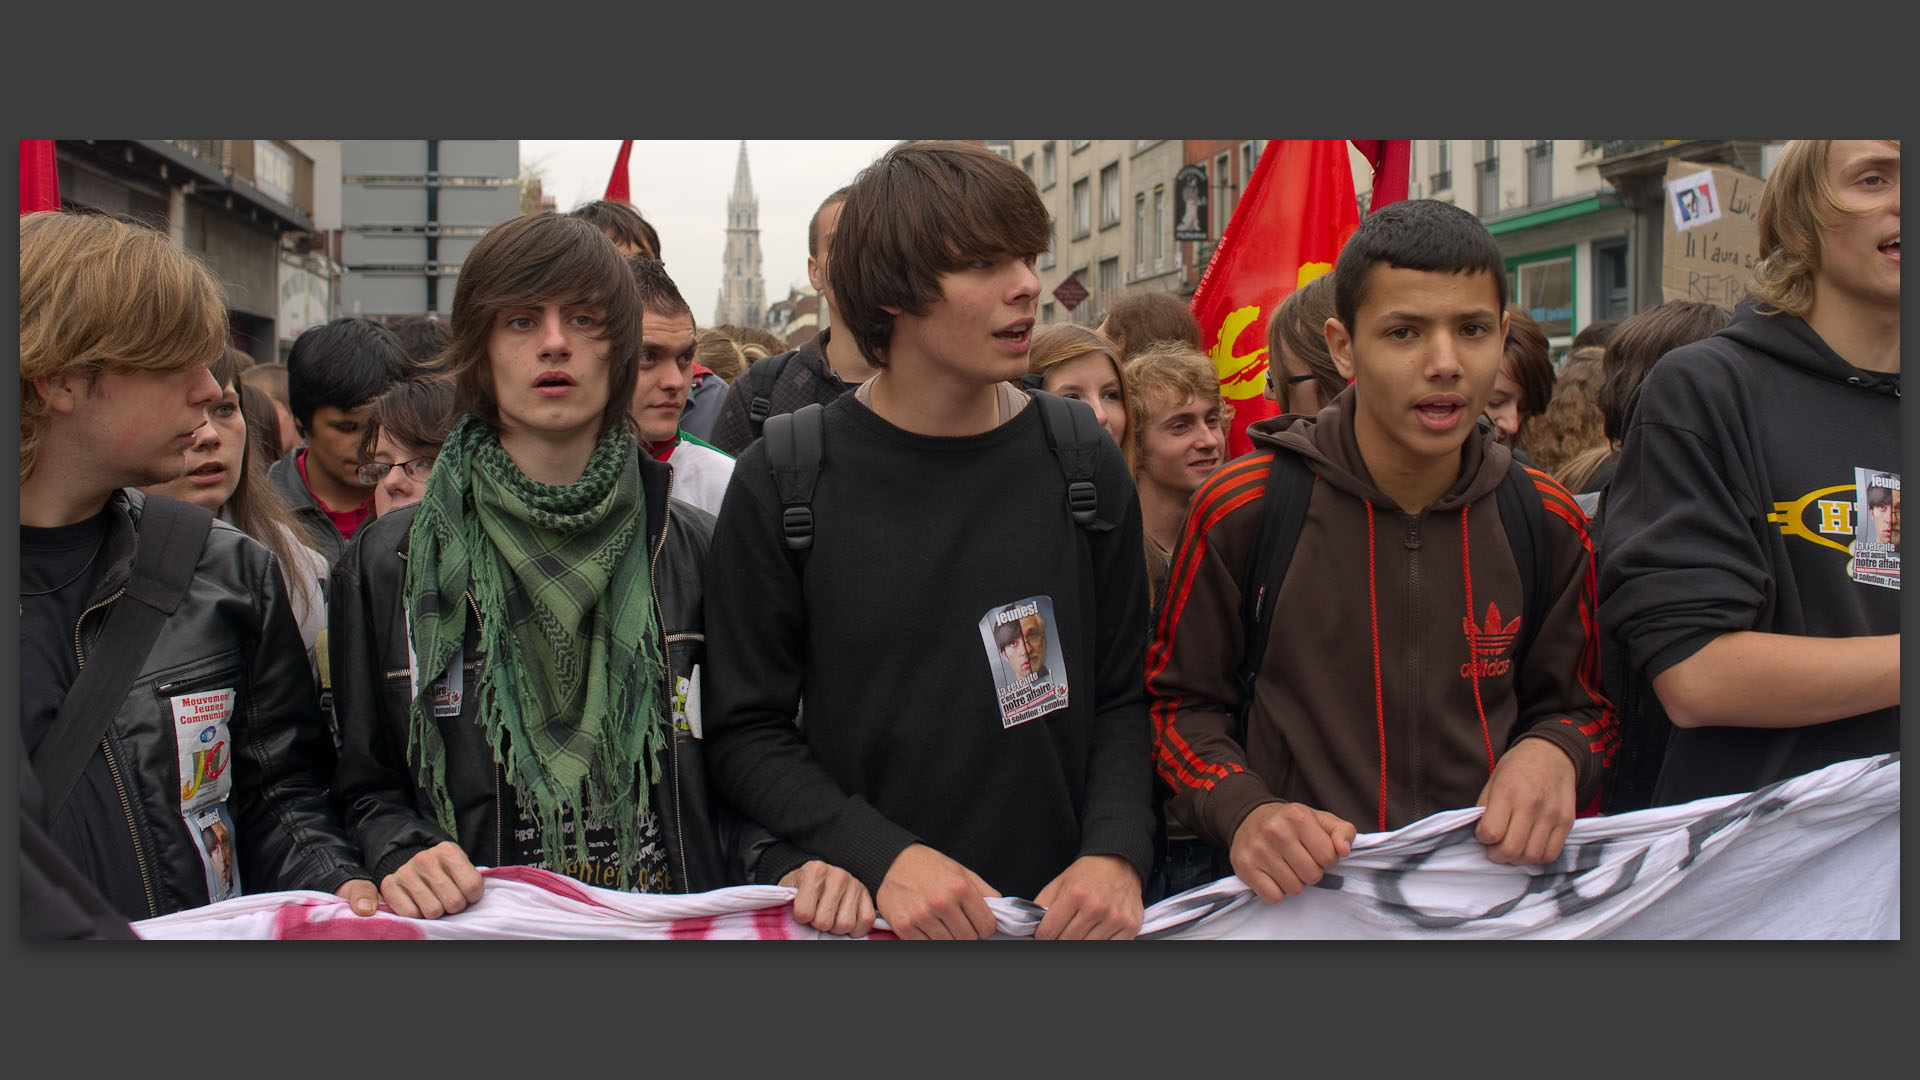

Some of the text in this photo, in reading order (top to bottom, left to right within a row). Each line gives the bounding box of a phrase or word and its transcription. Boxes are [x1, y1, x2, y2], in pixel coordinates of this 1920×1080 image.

[1729, 178, 1756, 220] Lui,
[1818, 500, 1857, 535] H
[1865, 542, 1896, 552] retraite
[1856, 558, 1877, 568] notre
[995, 600, 1039, 627] jeunes!
[1460, 658, 1510, 678] adidas
[997, 671, 1039, 698] la retraite
[194, 703, 224, 714] Jeunes
[1002, 697, 1026, 713] notre
[1011, 709, 1039, 724] solution
